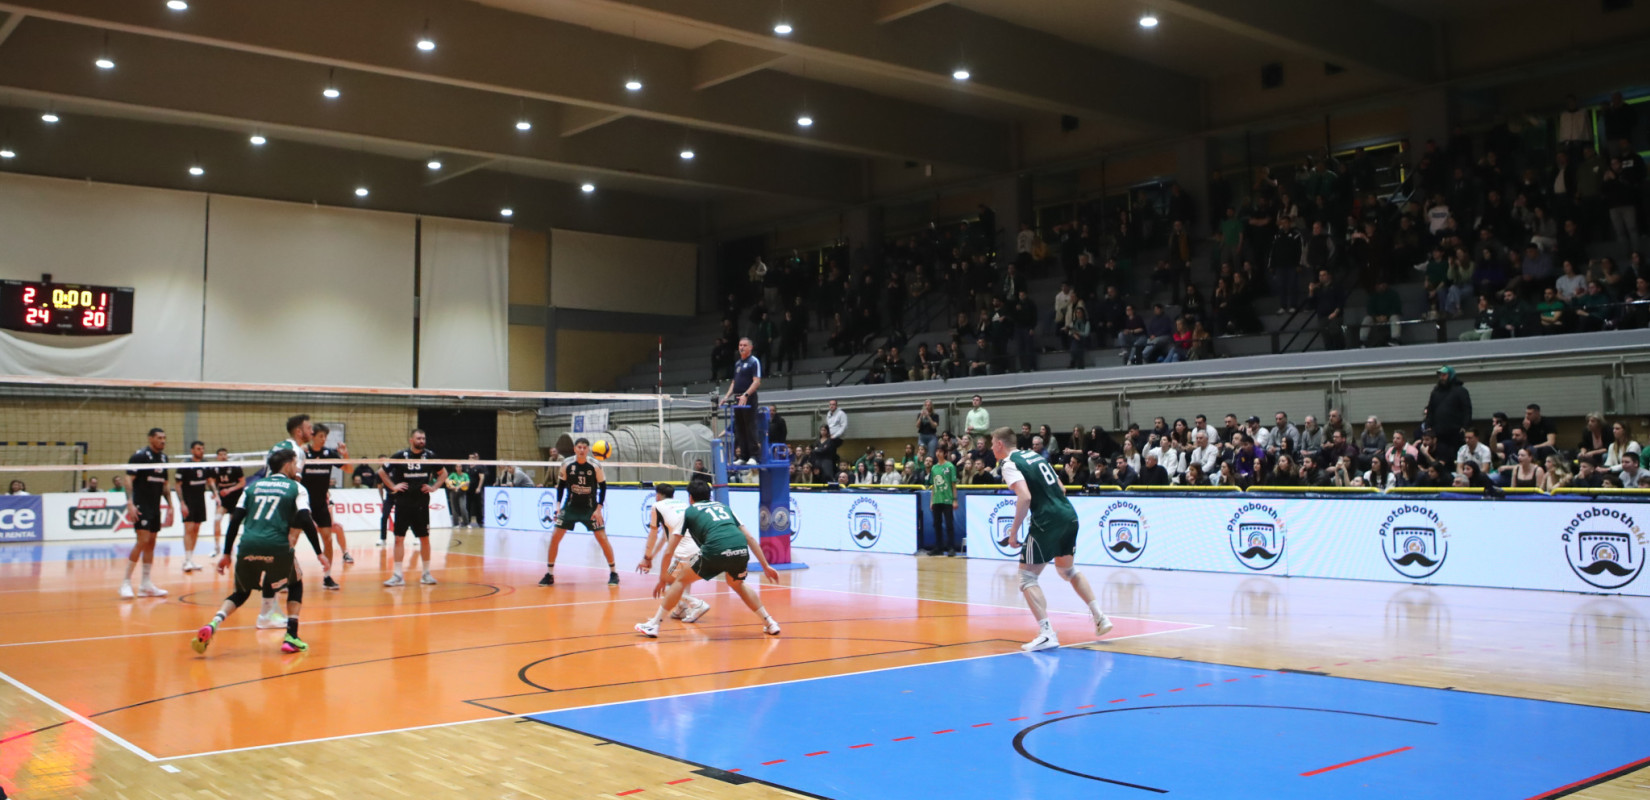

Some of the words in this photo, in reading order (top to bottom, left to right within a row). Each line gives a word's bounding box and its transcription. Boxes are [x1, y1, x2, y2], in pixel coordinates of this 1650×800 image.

[24, 288, 35, 303] 2
[101, 293, 106, 306] 1
[26, 308, 49, 324] 24
[83, 311, 105, 327] 20
[578, 476, 586, 485] 31
[1038, 462, 1059, 485] 8
[253, 495, 280, 520] 77
[704, 506, 730, 521] 13
[1379, 502, 1452, 536] Photoboothaki
[1562, 507, 1649, 545] Photoboothaki
